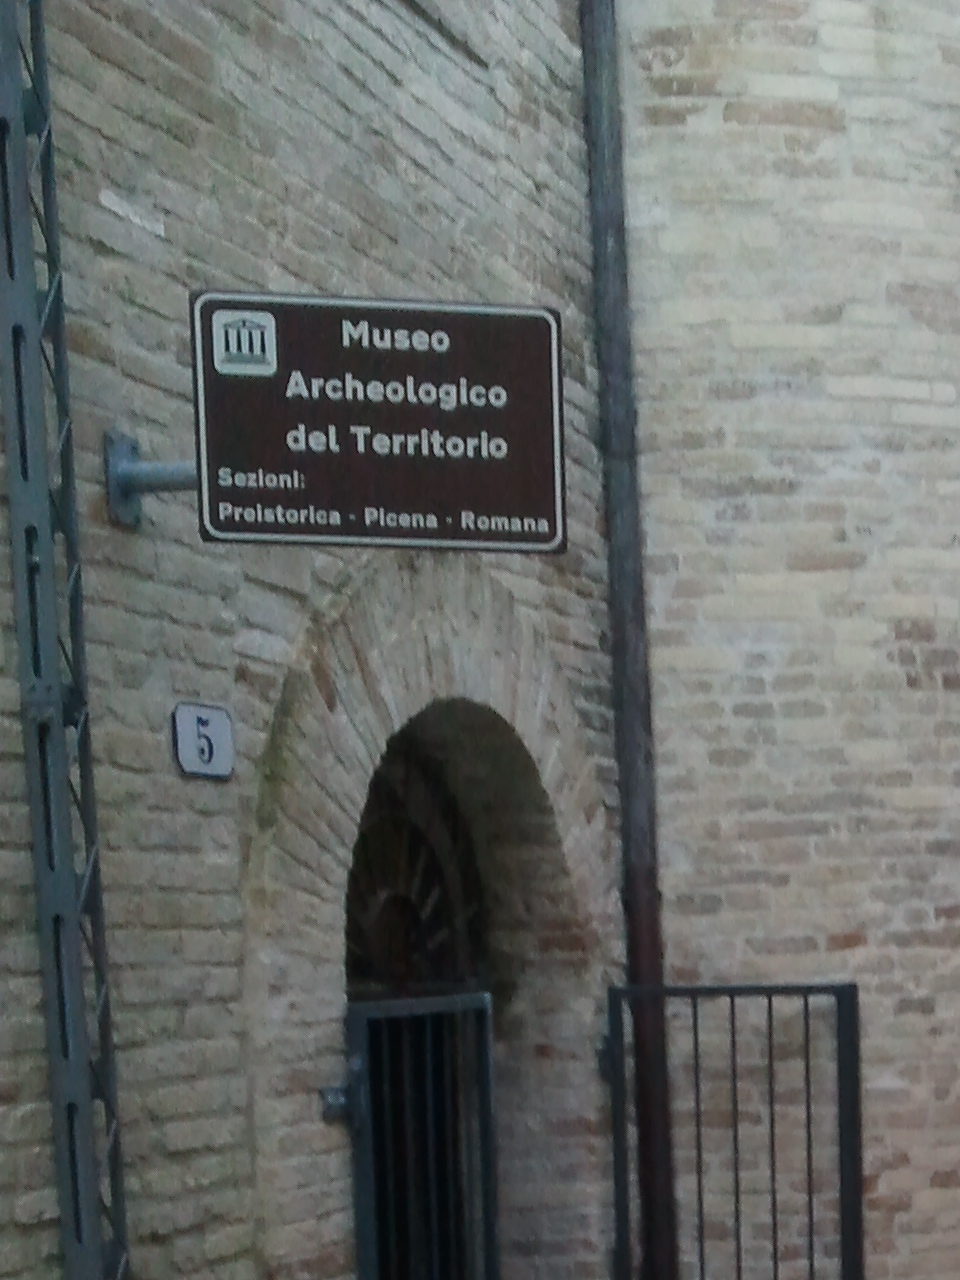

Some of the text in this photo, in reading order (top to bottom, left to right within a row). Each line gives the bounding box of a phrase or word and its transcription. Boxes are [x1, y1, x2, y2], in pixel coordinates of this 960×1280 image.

[341, 319, 450, 352] Museo
[285, 370, 508, 411] Archeologico
[285, 424, 508, 460] del Territorio
[217, 466, 306, 489] Sezioni:
[217, 502, 341, 526] Preistorica
[364, 506, 438, 529] Picena
[460, 510, 550, 533] Romana
[197, 716, 213, 765] 5
